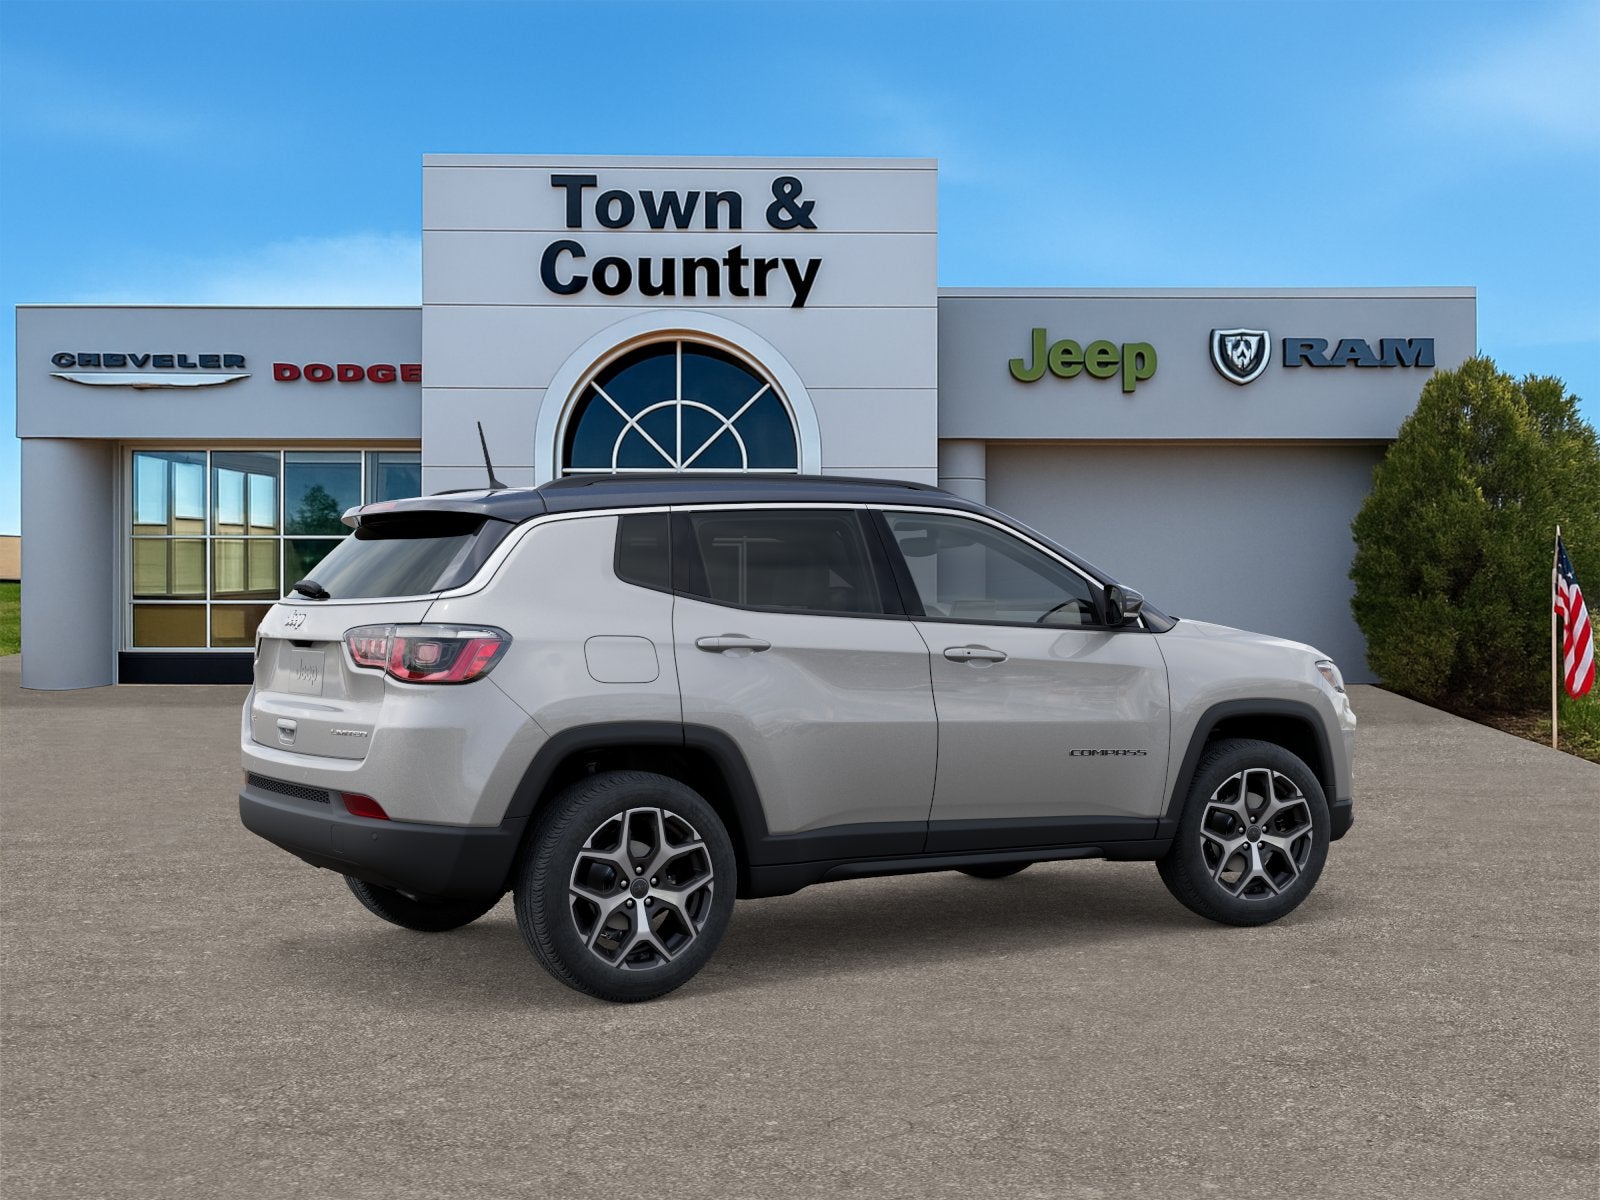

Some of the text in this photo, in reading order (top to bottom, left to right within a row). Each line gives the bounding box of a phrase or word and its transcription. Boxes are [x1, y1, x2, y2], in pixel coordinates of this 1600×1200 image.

[550, 174, 818, 230] Town &
[539, 239, 823, 308] Country
[272, 362, 422, 384] DODGE
[1008, 328, 1158, 393] Jeep
[1282, 337, 1436, 368] RAM
[1069, 748, 1148, 757] COMPASS
